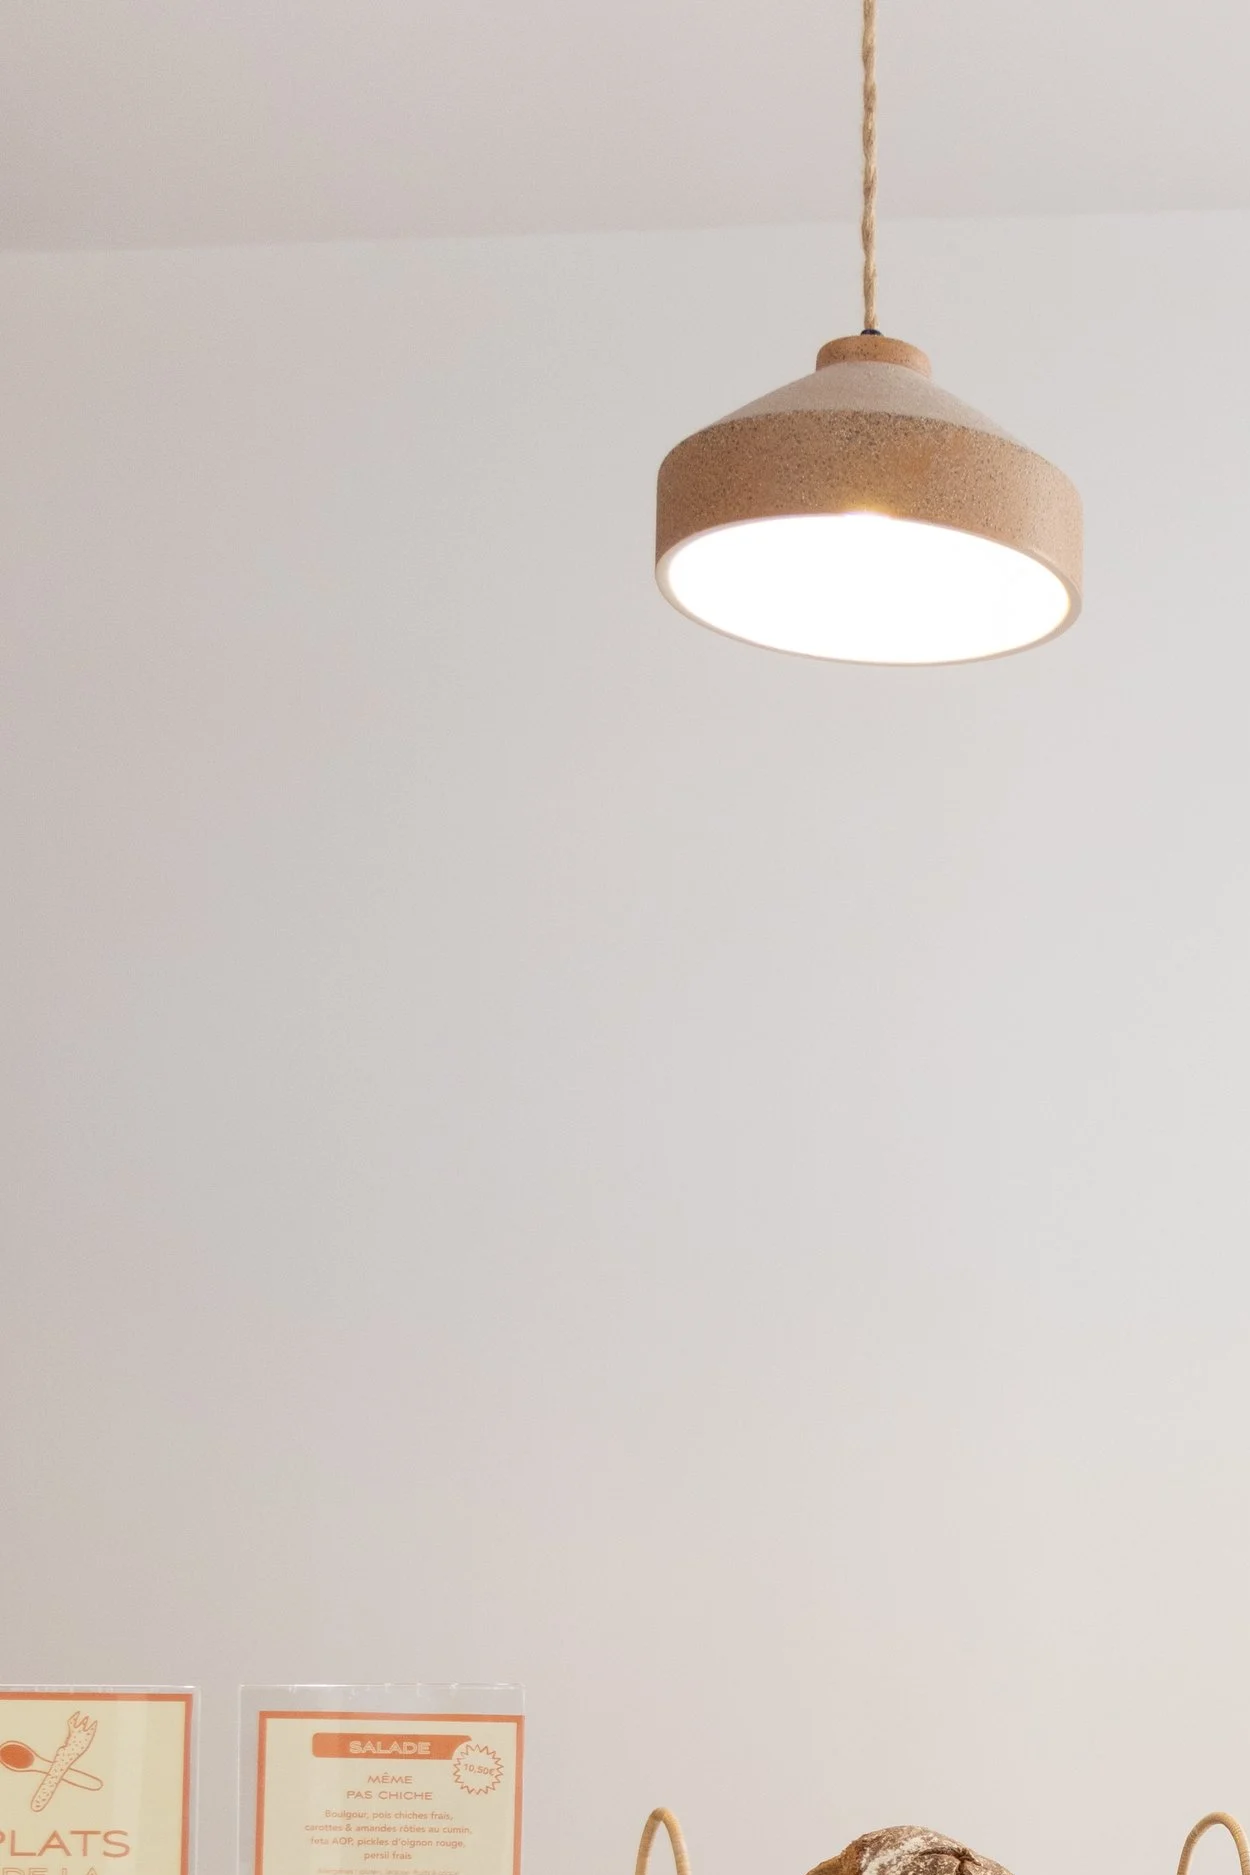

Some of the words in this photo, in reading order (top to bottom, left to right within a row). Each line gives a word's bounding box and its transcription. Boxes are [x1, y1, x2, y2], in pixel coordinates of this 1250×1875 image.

[350, 1740, 431, 1755] SALADE
[367, 1772, 413, 1784] MÊME
[346, 1791, 373, 1799] PAS
[378, 1791, 433, 1800] CHICHE
[0, 1830, 130, 1858] LATS
